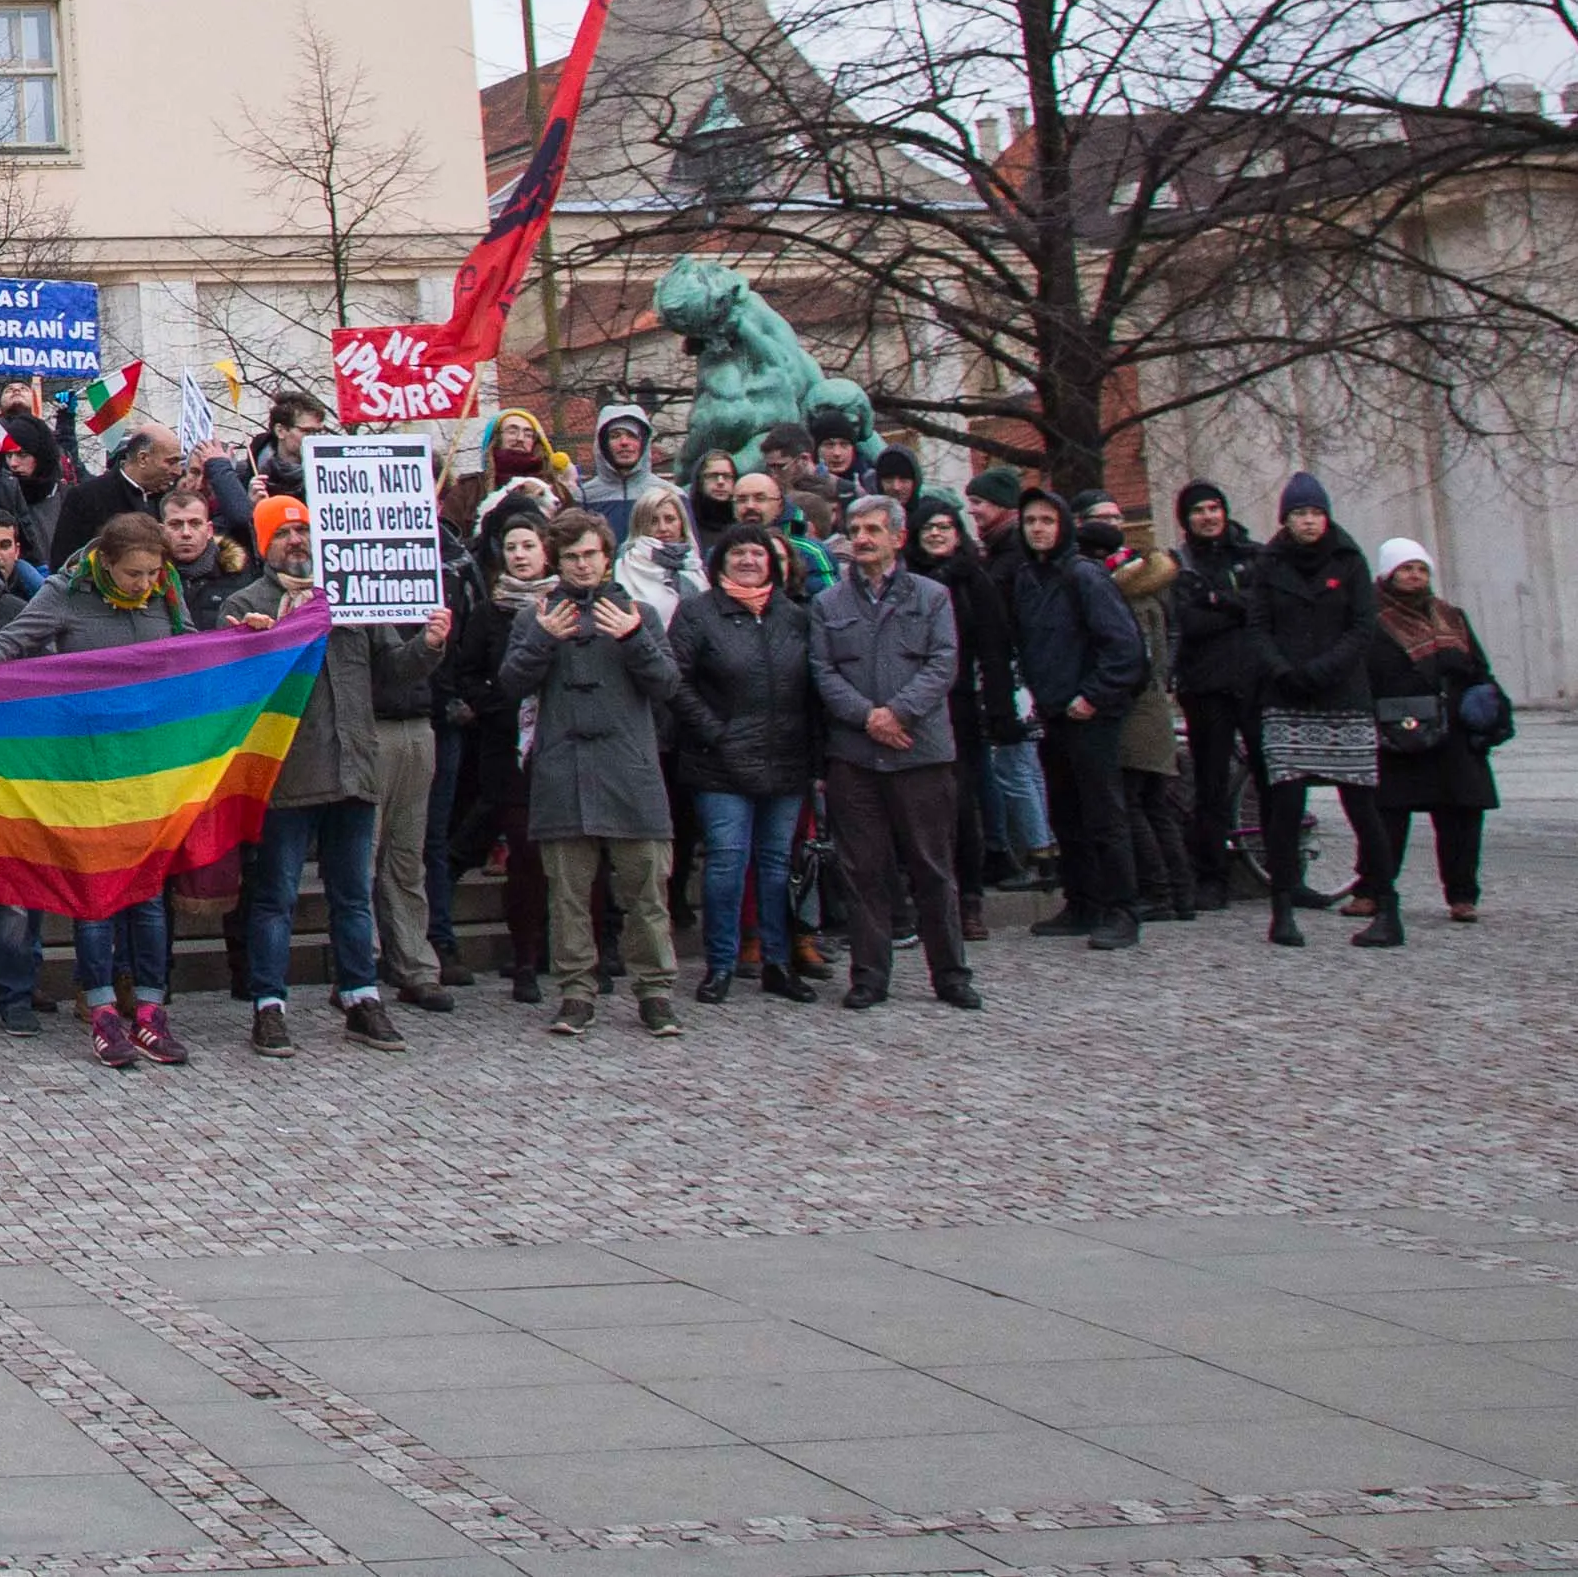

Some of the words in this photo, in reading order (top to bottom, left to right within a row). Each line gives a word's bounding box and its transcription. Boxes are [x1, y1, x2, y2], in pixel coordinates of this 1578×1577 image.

[68, 321, 95, 340] JE
[316, 464, 375, 497] Rusko,
[379, 464, 422, 493] NATO
[320, 501, 372, 534] stejná
[376, 500, 433, 531] verbež
[324, 542, 436, 572] Solidaritu
[326, 580, 341, 604] s
[330, 607, 435, 618] ww.socsol.c
